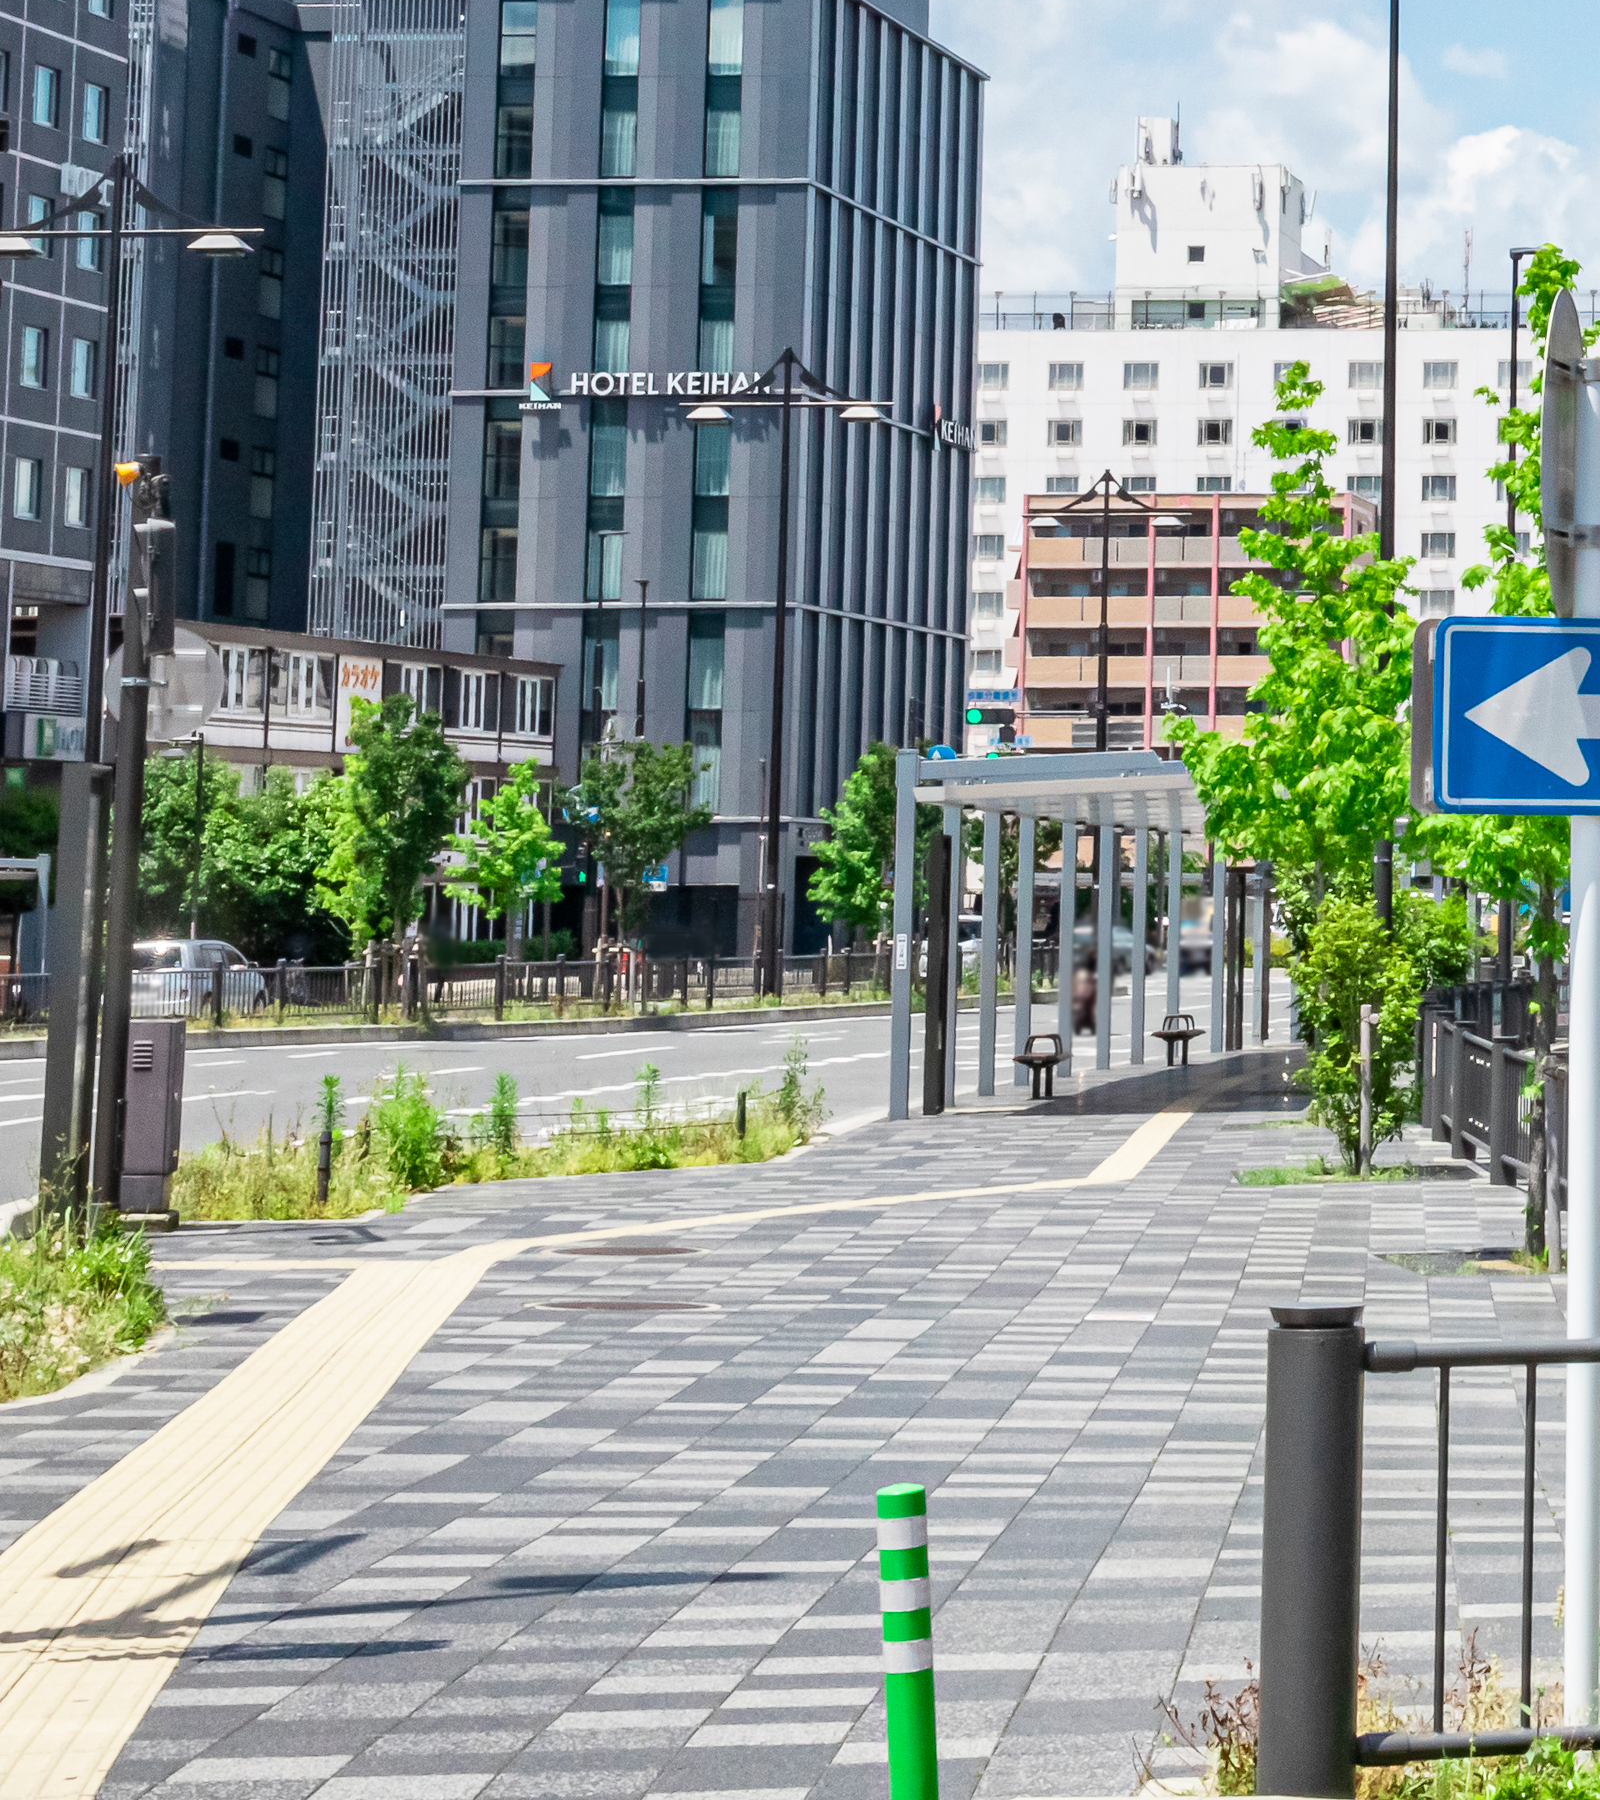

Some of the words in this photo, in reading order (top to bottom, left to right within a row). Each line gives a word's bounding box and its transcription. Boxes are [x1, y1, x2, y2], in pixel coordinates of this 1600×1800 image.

[571, 372, 659, 395] HOTEL
[518, 402, 561, 410] KEIHAN
[941, 418, 976, 451] KEIHAN
[341, 661, 380, 690] カラオケ
